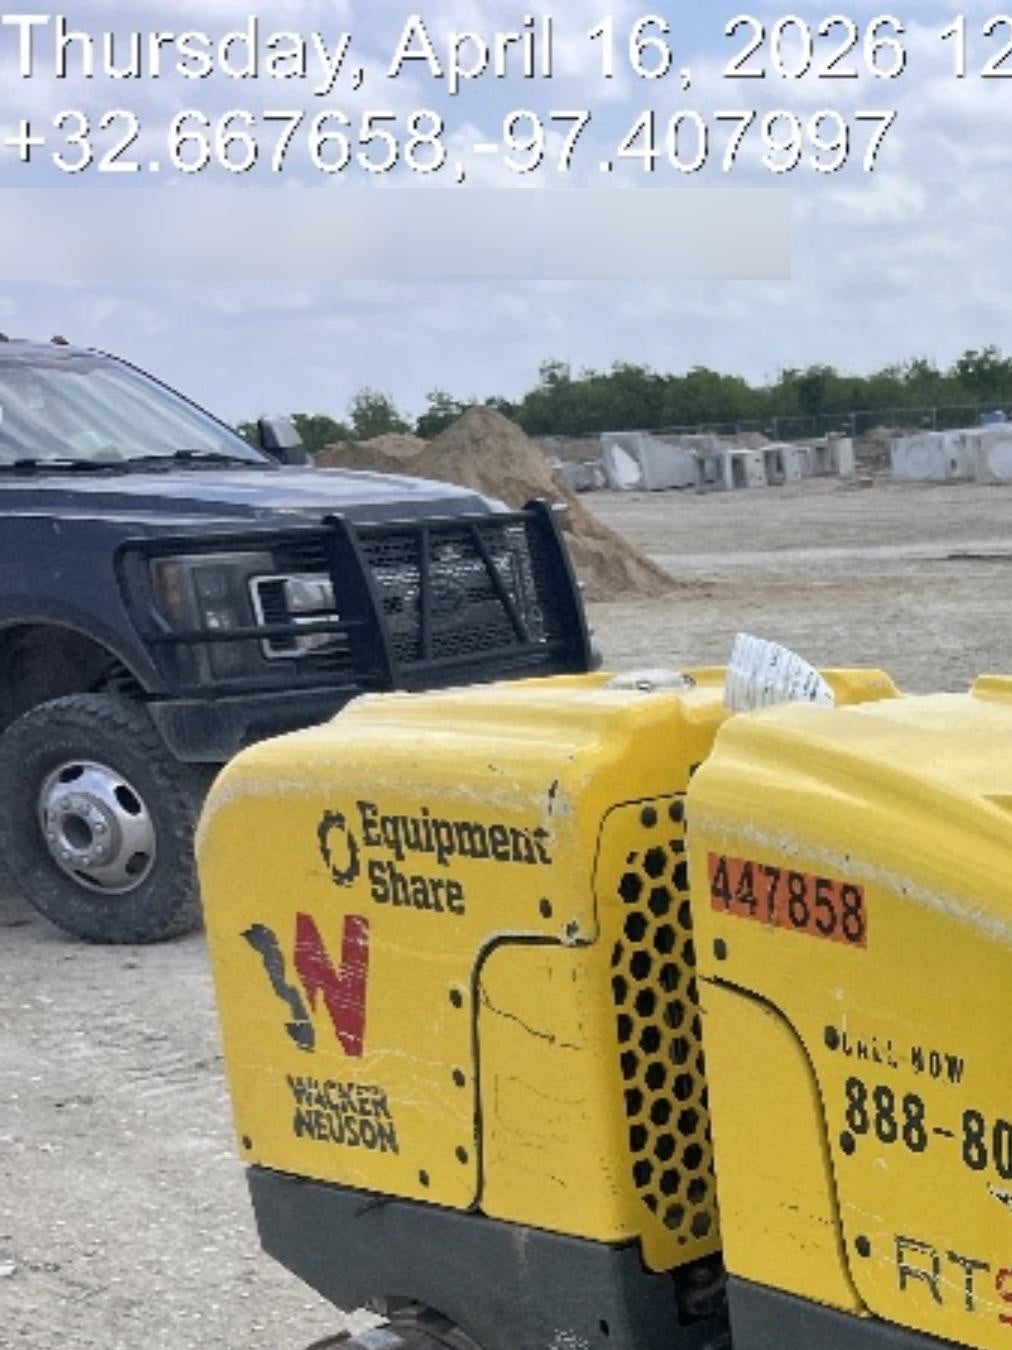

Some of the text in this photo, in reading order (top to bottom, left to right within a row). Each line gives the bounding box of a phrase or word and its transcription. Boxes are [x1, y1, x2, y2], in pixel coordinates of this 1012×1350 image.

[357, 801, 552, 866] Equipment
[368, 860, 466, 916] Share
[709, 854, 866, 944] 447858
[911, 1046, 964, 1084] NOW
[286, 1074, 392, 1120] WACKER
[294, 1106, 400, 1156] NEUSON
